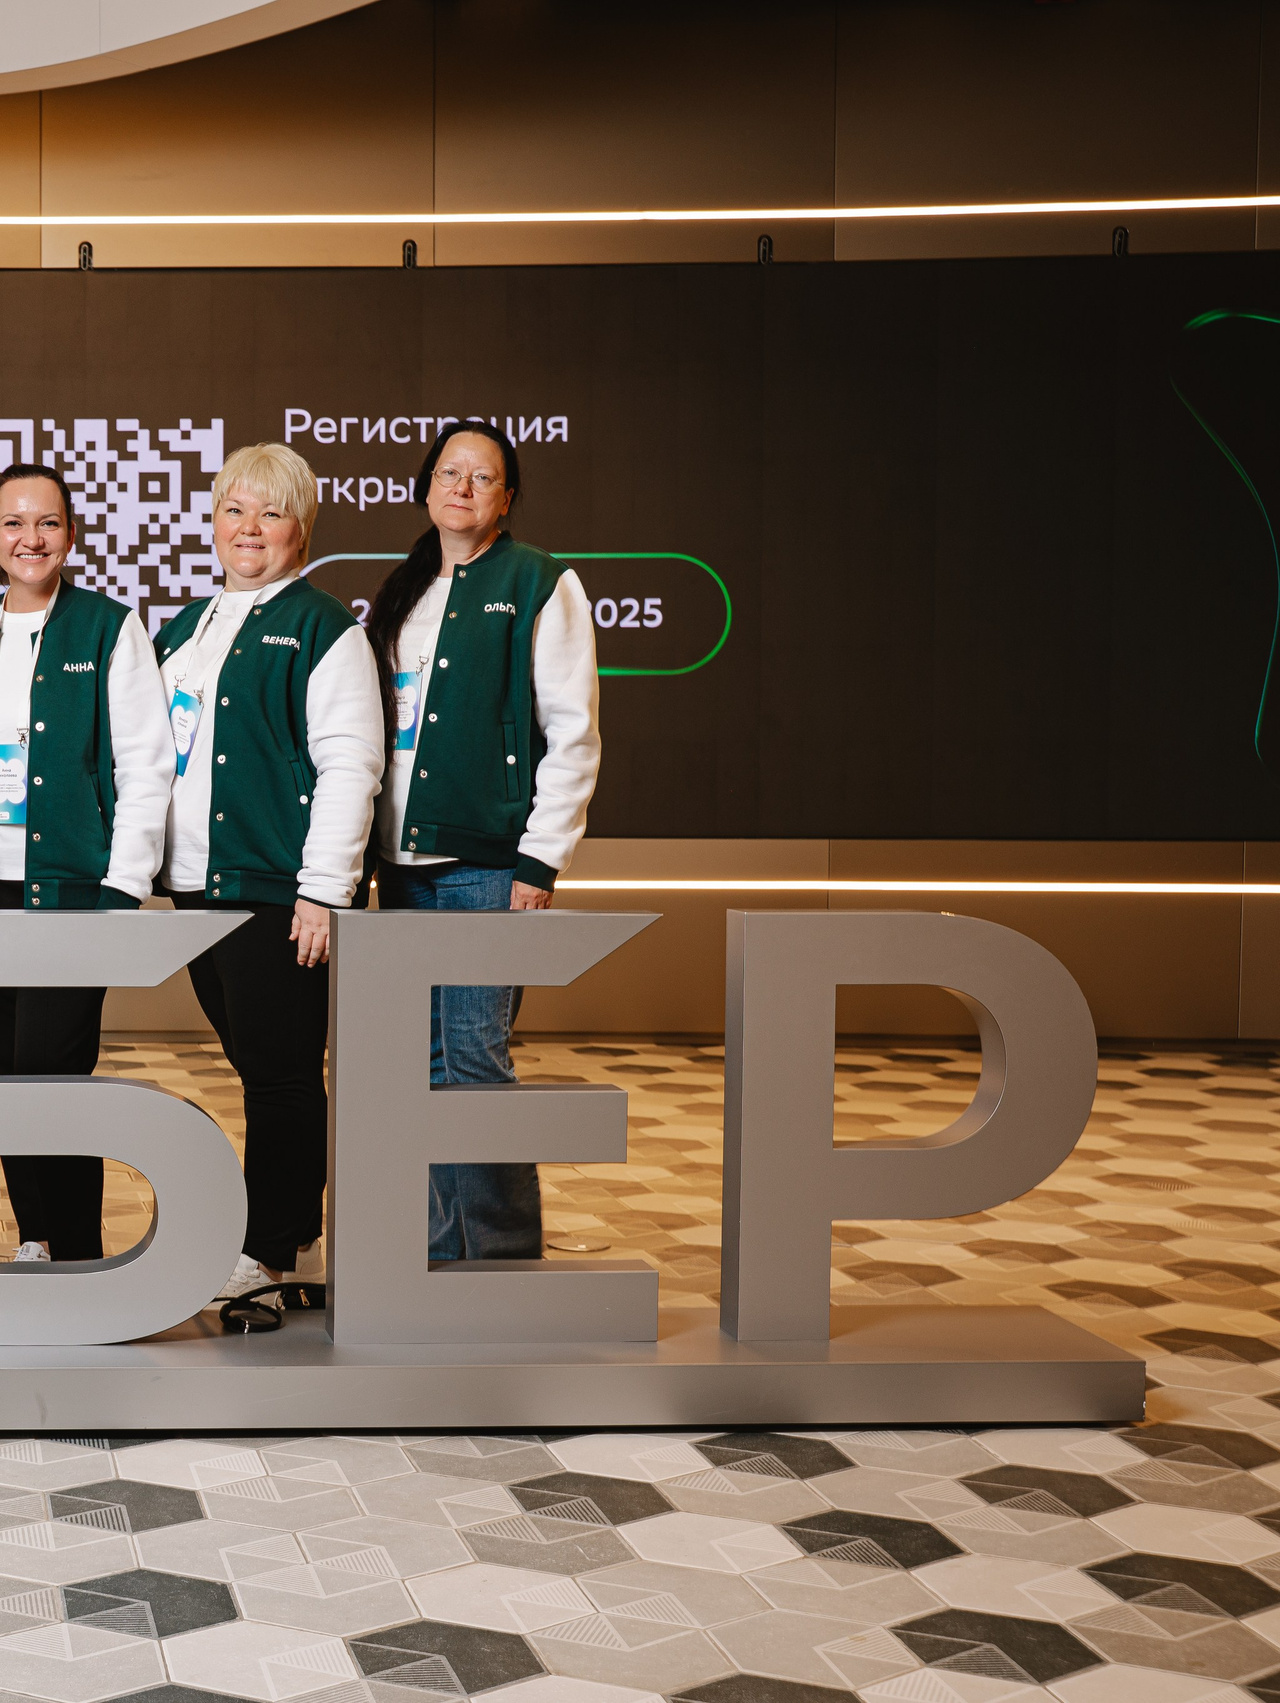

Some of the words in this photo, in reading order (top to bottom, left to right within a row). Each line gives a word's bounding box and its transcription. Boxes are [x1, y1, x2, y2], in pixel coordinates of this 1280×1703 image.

[284, 408, 568, 448] Регистция
[484, 602, 516, 616] ОЛЬГА
[587, 597, 663, 629] 025
[261, 635, 301, 651] ВЕНЕРА
[63, 661, 95, 673] АННА
